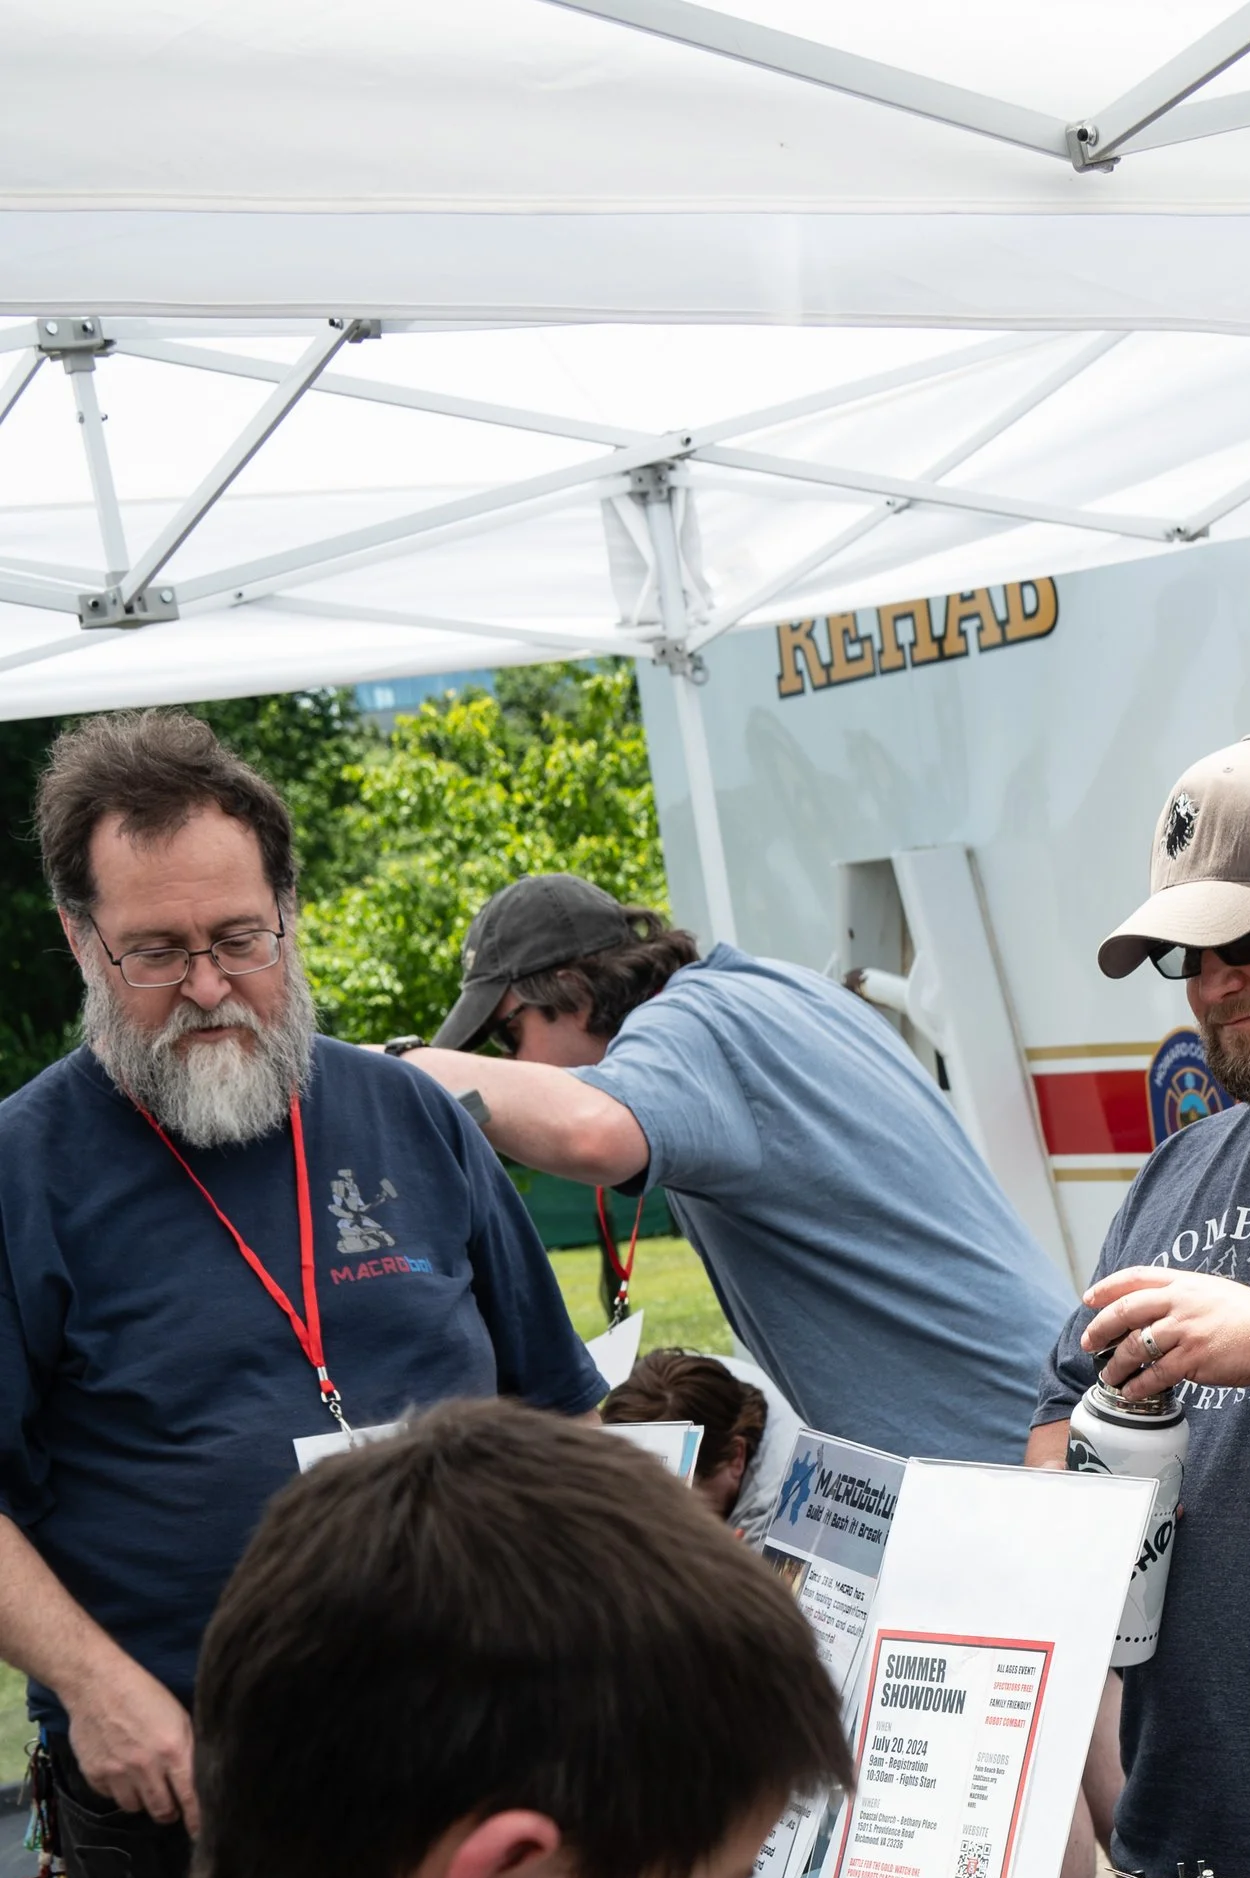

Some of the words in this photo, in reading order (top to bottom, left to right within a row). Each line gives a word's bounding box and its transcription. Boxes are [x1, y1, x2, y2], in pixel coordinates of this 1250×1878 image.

[805, 1503, 825, 1522] Build
[830, 1512, 850, 1532] Bash
[857, 1522, 883, 1544] Break
[835, 1580, 854, 1596] MACRO
[853, 1587, 865, 1601] has
[835, 1619, 847, 1631] and
[886, 1654, 947, 1683] SUMMER
[1005, 1665, 1018, 1674] AGES
[1018, 1666, 1036, 1675] EVENT!
[993, 1682, 1021, 1691] SPECTATORS
[881, 1683, 967, 1714] SHOWDOWN
[990, 1698, 1006, 1708] FAMILY
[1007, 1700, 1031, 1710] FRIENDLY!
[876, 1721, 892, 1732] WHEN
[985, 1716, 1003, 1726] ROBOT
[1003, 1718, 1026, 1728] COMBAT!
[872, 1735, 890, 1753] July
[891, 1737, 904, 1754] 20,
[906, 1739, 928, 1756] 2024
[869, 1754, 884, 1767] 9am
[888, 1757, 928, 1772] Registration
[977, 1752, 1009, 1765] SPONSORS
[867, 1769, 894, 1783] 10:30am
[899, 1773, 919, 1787] Fights
[919, 1776, 936, 1789] Start
[862, 1797, 880, 1808] WHERE
[859, 1810, 878, 1821] Coastal
[878, 1813, 896, 1823] Church
[900, 1816, 921, 1828] Bethany
[922, 1819, 937, 1830] Place
[858, 1822, 869, 1831] 1501
[873, 1824, 901, 1837] Providence
[901, 1828, 915, 1839] Road
[962, 1824, 989, 1838] WEBSITE
